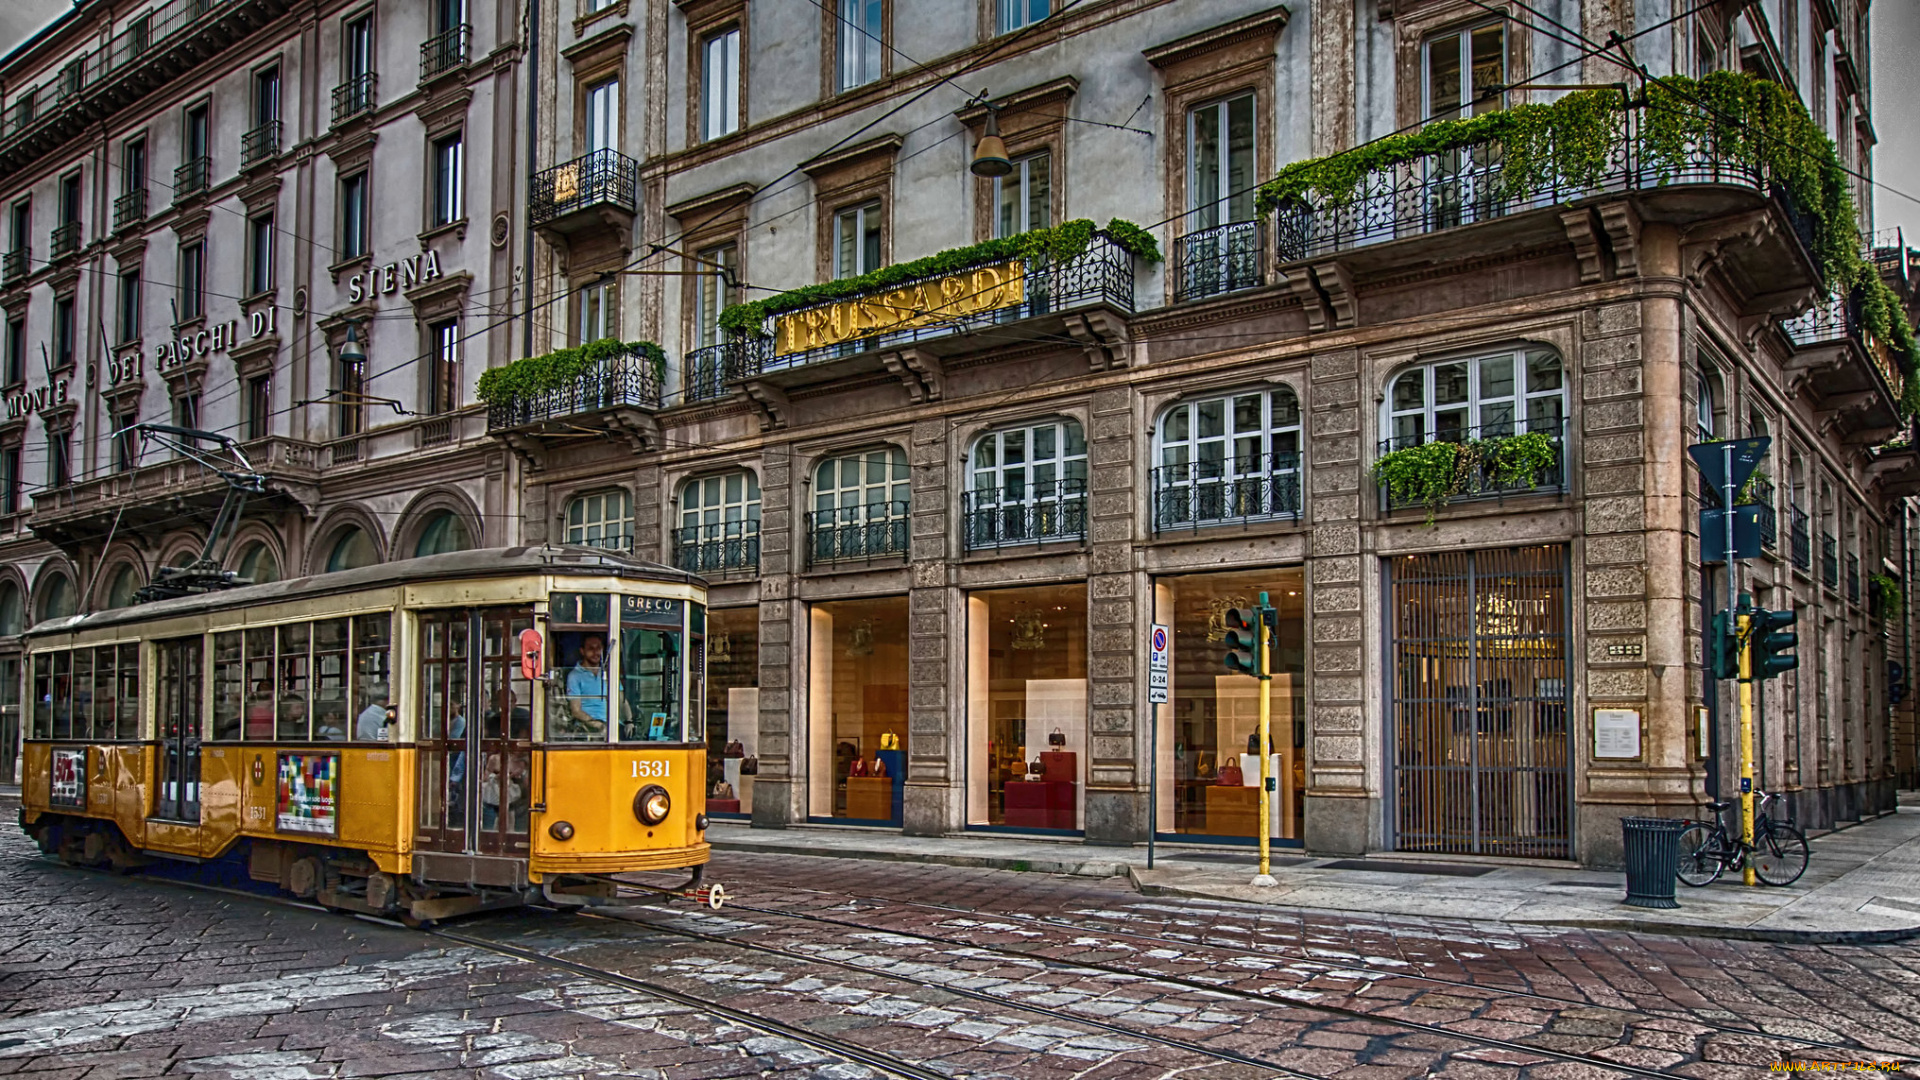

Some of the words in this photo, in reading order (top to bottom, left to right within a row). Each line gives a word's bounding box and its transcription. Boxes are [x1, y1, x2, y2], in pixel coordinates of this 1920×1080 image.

[777, 260, 1025, 354] TRUSSARDI
[7, 380, 66, 419] MONTE
[109, 353, 142, 386] DEI
[155, 321, 235, 370] PASCHI
[251, 306, 275, 339] DI
[349, 249, 440, 303] SIENA
[627, 596, 672, 610] GRECO
[1152, 675, 1166, 684] 0-24
[631, 760, 671, 778] 1531
[250, 806, 267, 820] 1531
